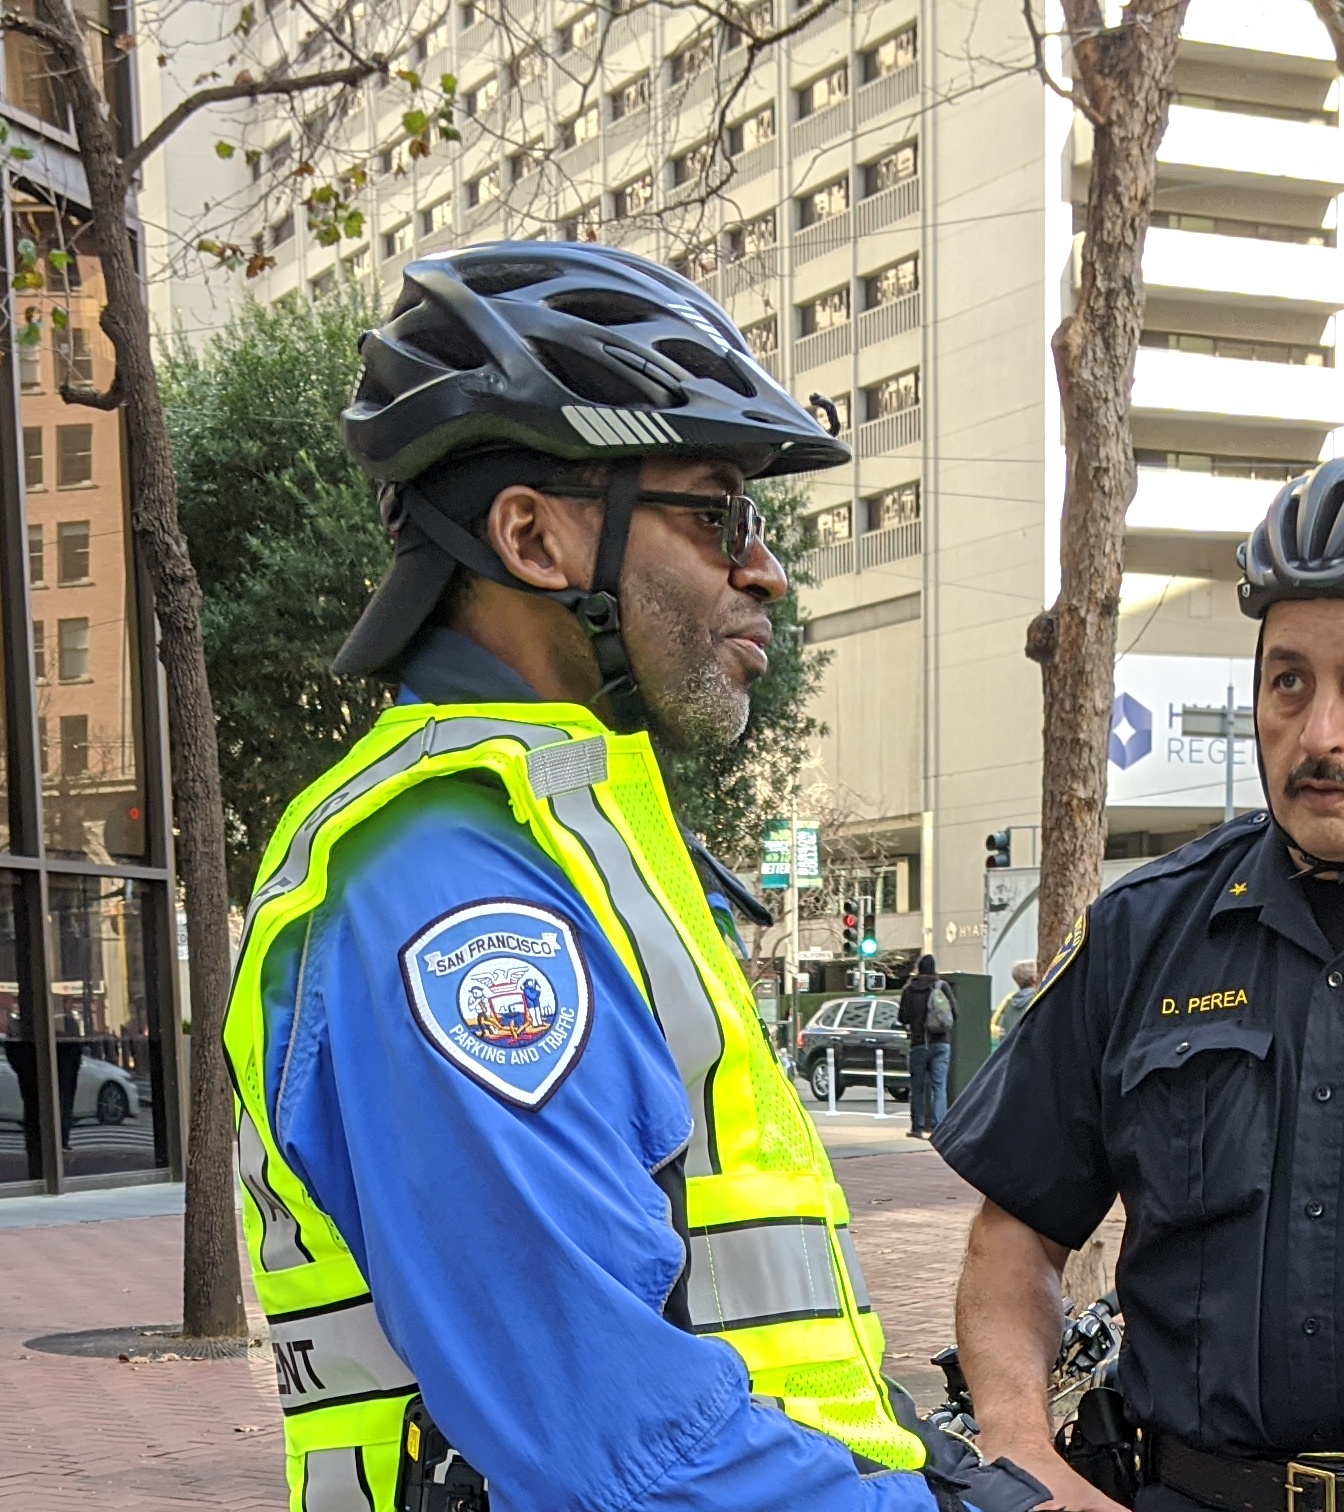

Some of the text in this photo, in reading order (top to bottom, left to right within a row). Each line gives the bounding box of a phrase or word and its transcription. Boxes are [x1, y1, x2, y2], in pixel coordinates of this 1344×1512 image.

[1167, 738, 1255, 765] REGE
[436, 934, 552, 973] SAN FRANCISCO
[1162, 989, 1248, 1014] D. PEREA
[449, 1006, 575, 1065] PARKING AND TRAFFIC
